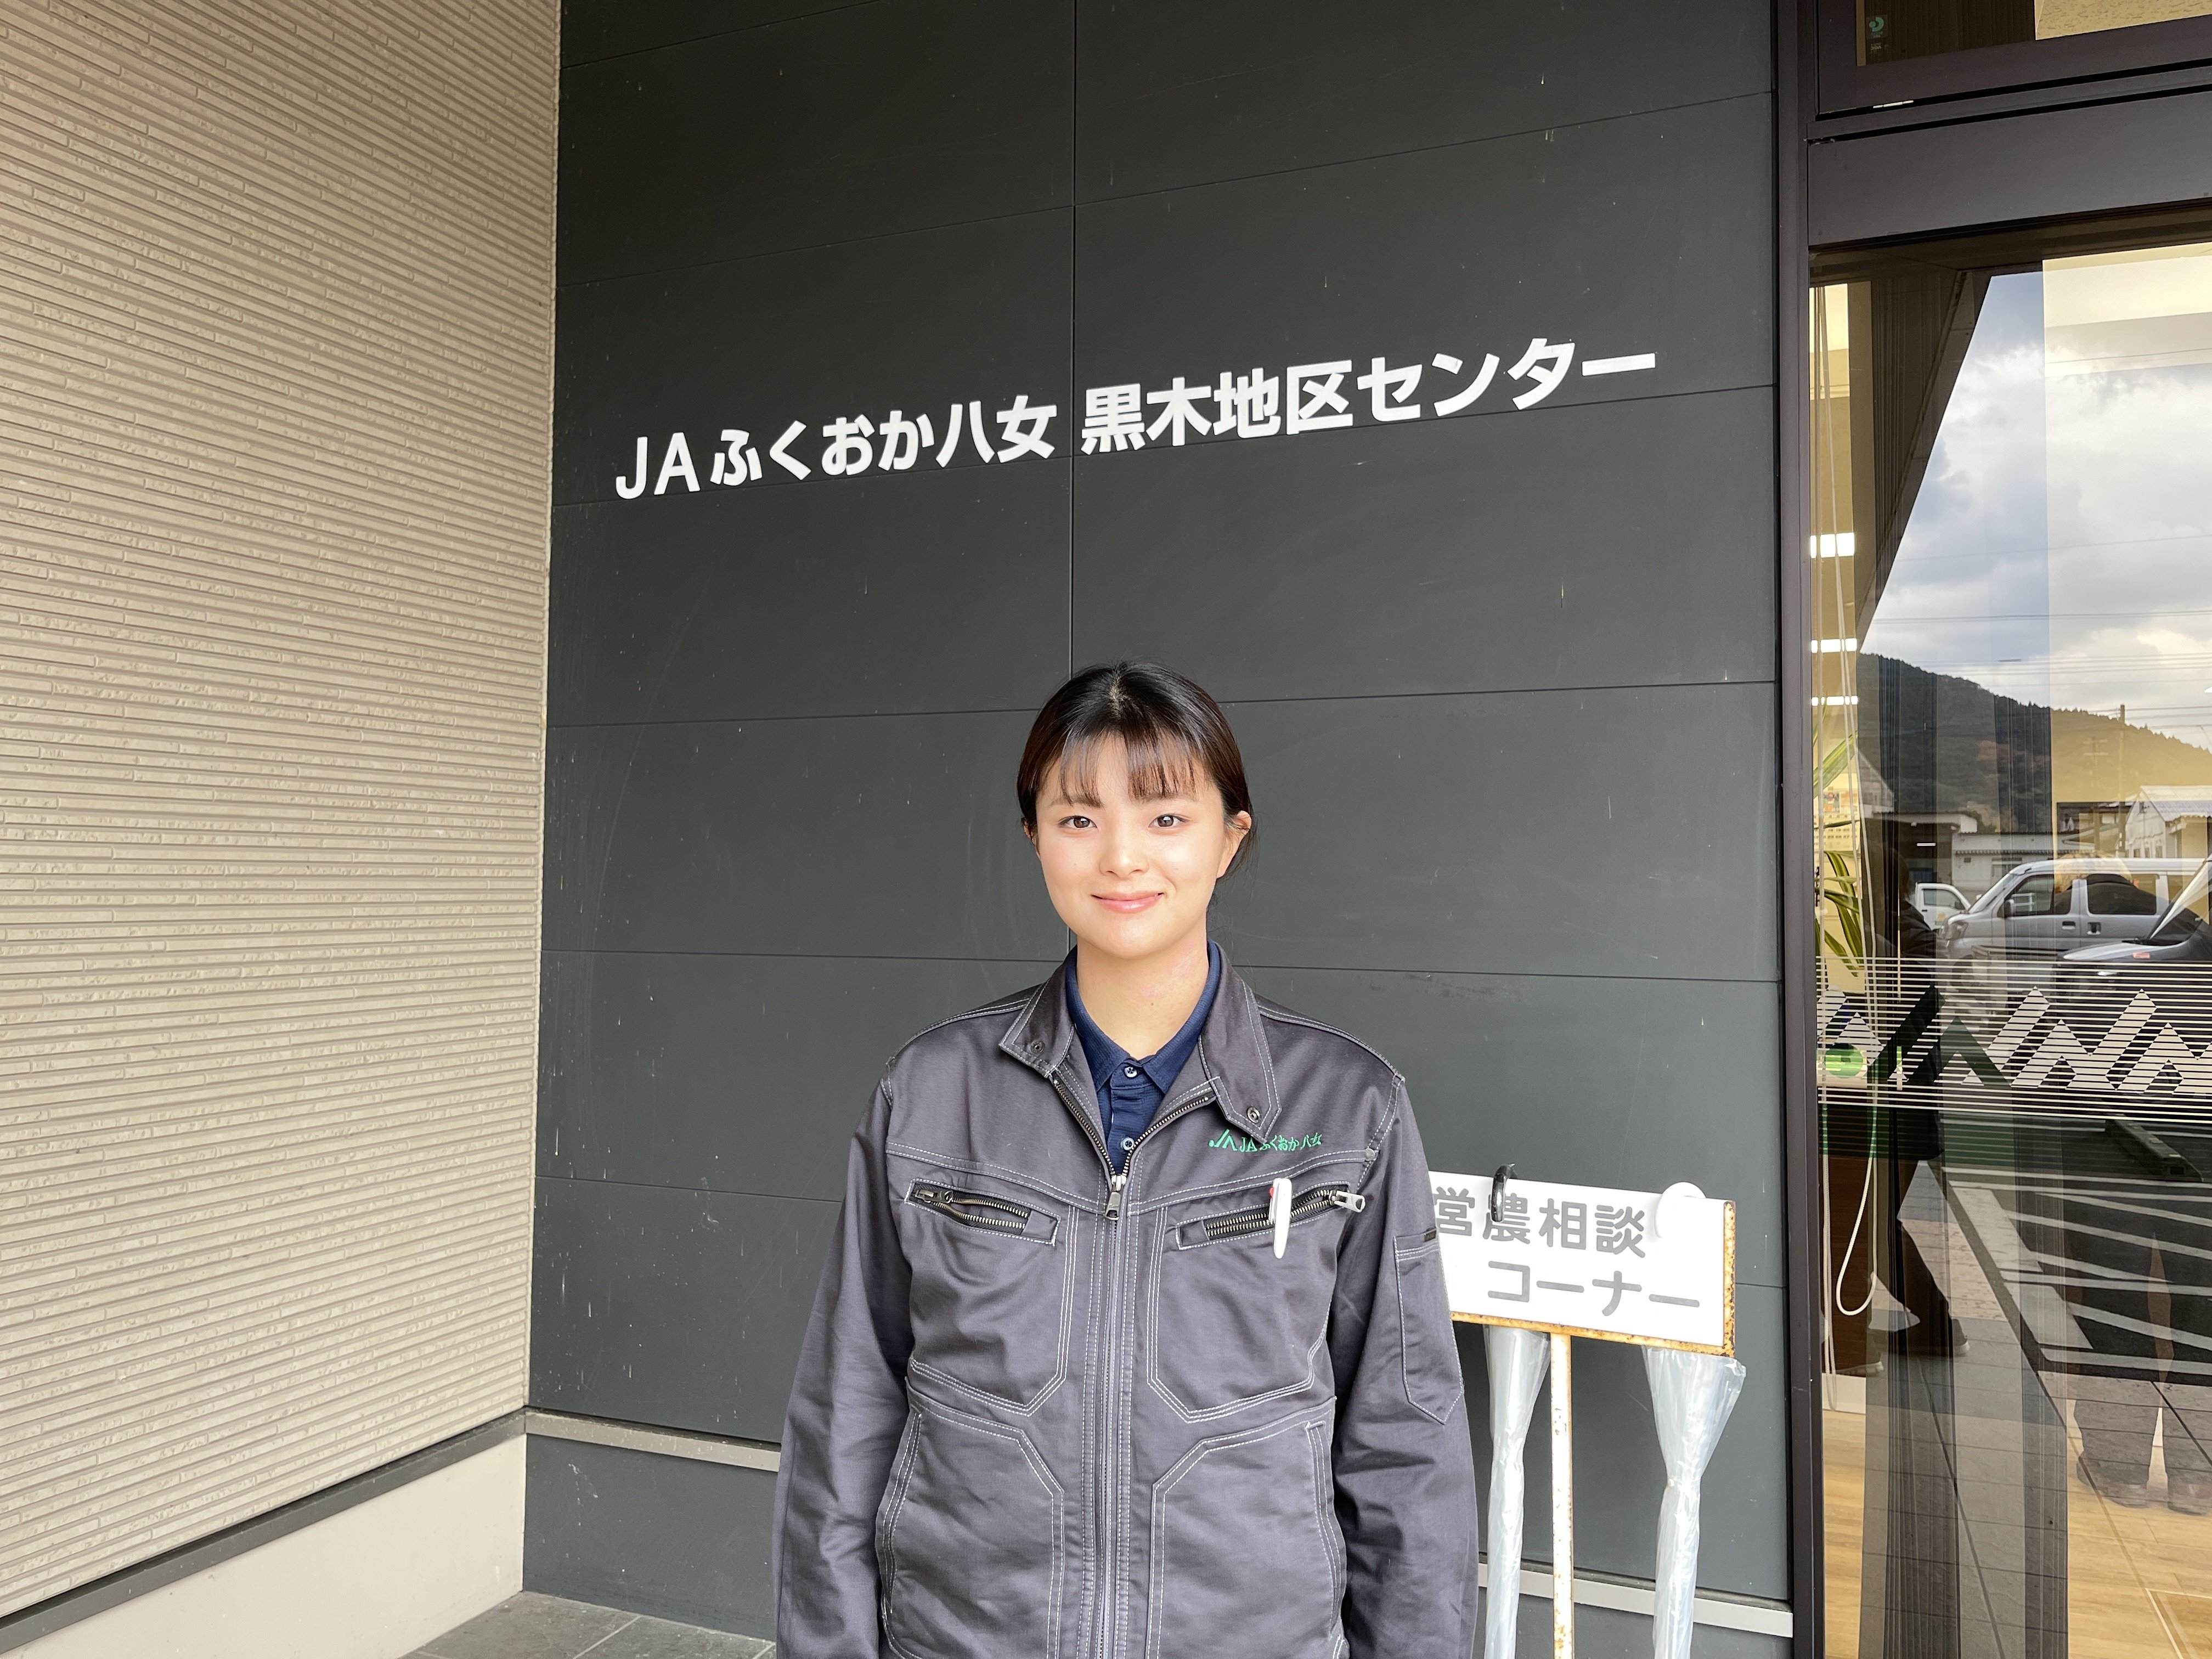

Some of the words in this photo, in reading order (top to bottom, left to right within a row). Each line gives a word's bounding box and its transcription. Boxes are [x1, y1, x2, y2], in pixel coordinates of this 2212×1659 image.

[616, 394, 1057, 500] JAふくおか八女
[1081, 338, 1656, 456] 黒木地区センター
[1432, 1186, 1646, 1259] 営農相談
[1487, 1261, 1700, 1317] コーナー
